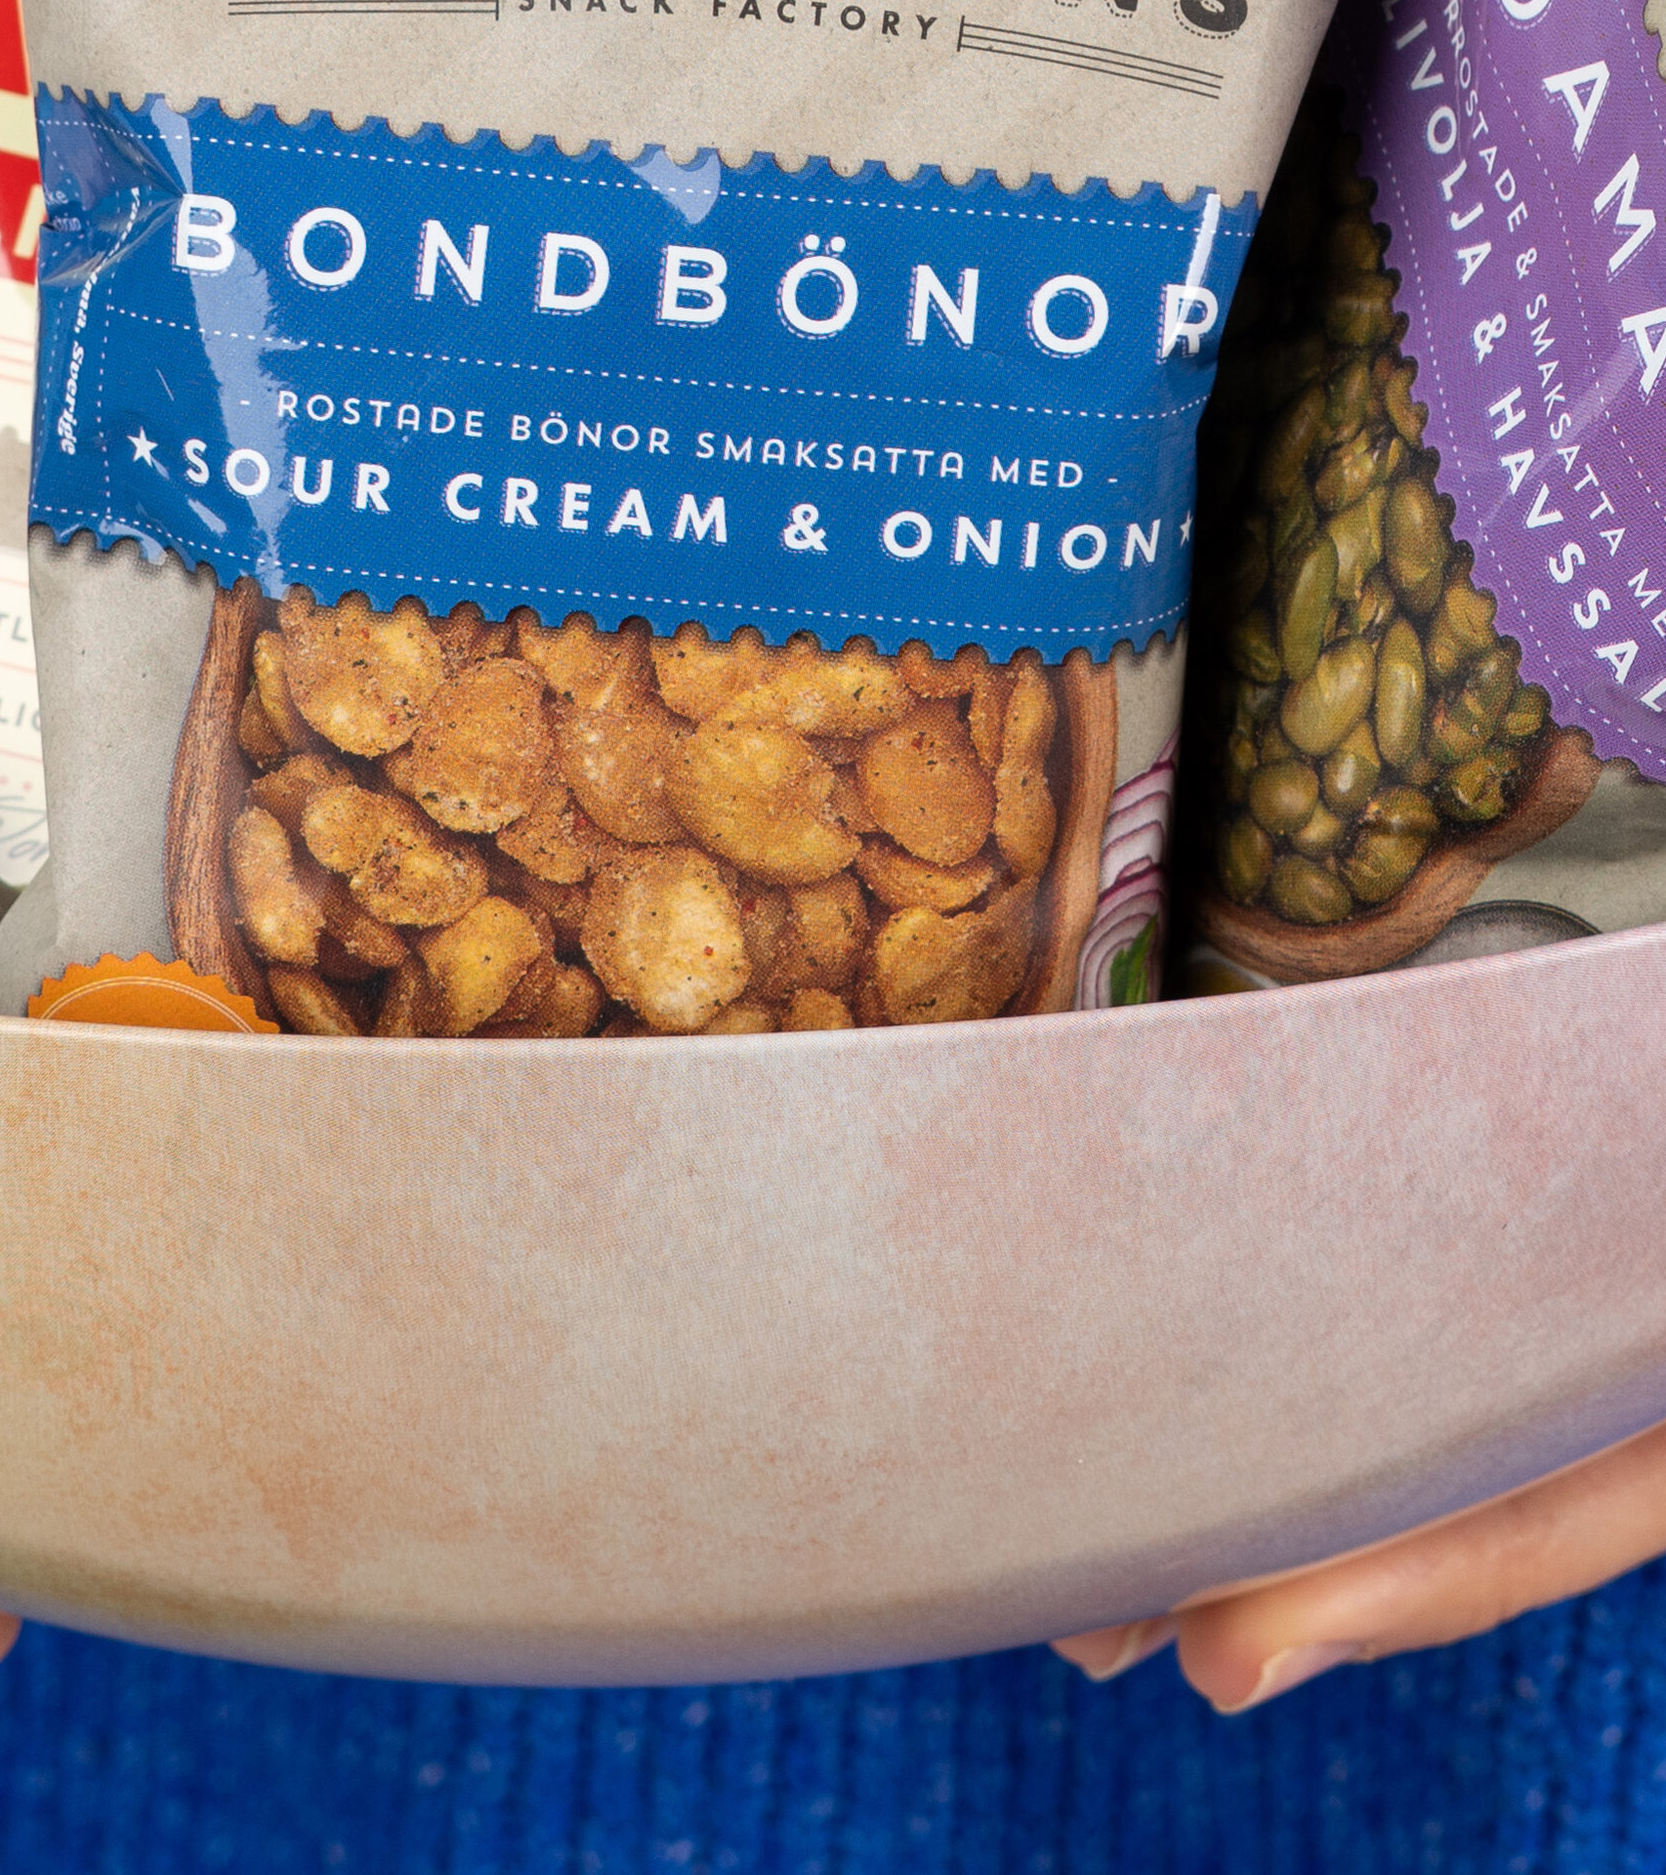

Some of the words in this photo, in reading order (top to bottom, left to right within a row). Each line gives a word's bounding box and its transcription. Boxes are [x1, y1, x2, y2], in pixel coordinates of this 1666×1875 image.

[171, 192, 1220, 363] BONDBÖNOR
[1515, 247, 1538, 280] &
[1472, 312, 1507, 364] &
[276, 389, 486, 439] ROSTADE
[510, 411, 671, 456] BÖNOR
[695, 430, 965, 482] SMAKSATTA
[990, 455, 1085, 489] MED
[1524, 292, 1627, 557] SMAKSATTA
[183, 438, 392, 514] SOUR
[442, 471, 729, 545] CREAM
[782, 503, 829, 553] &
[879, 510, 1162, 572] ONION
